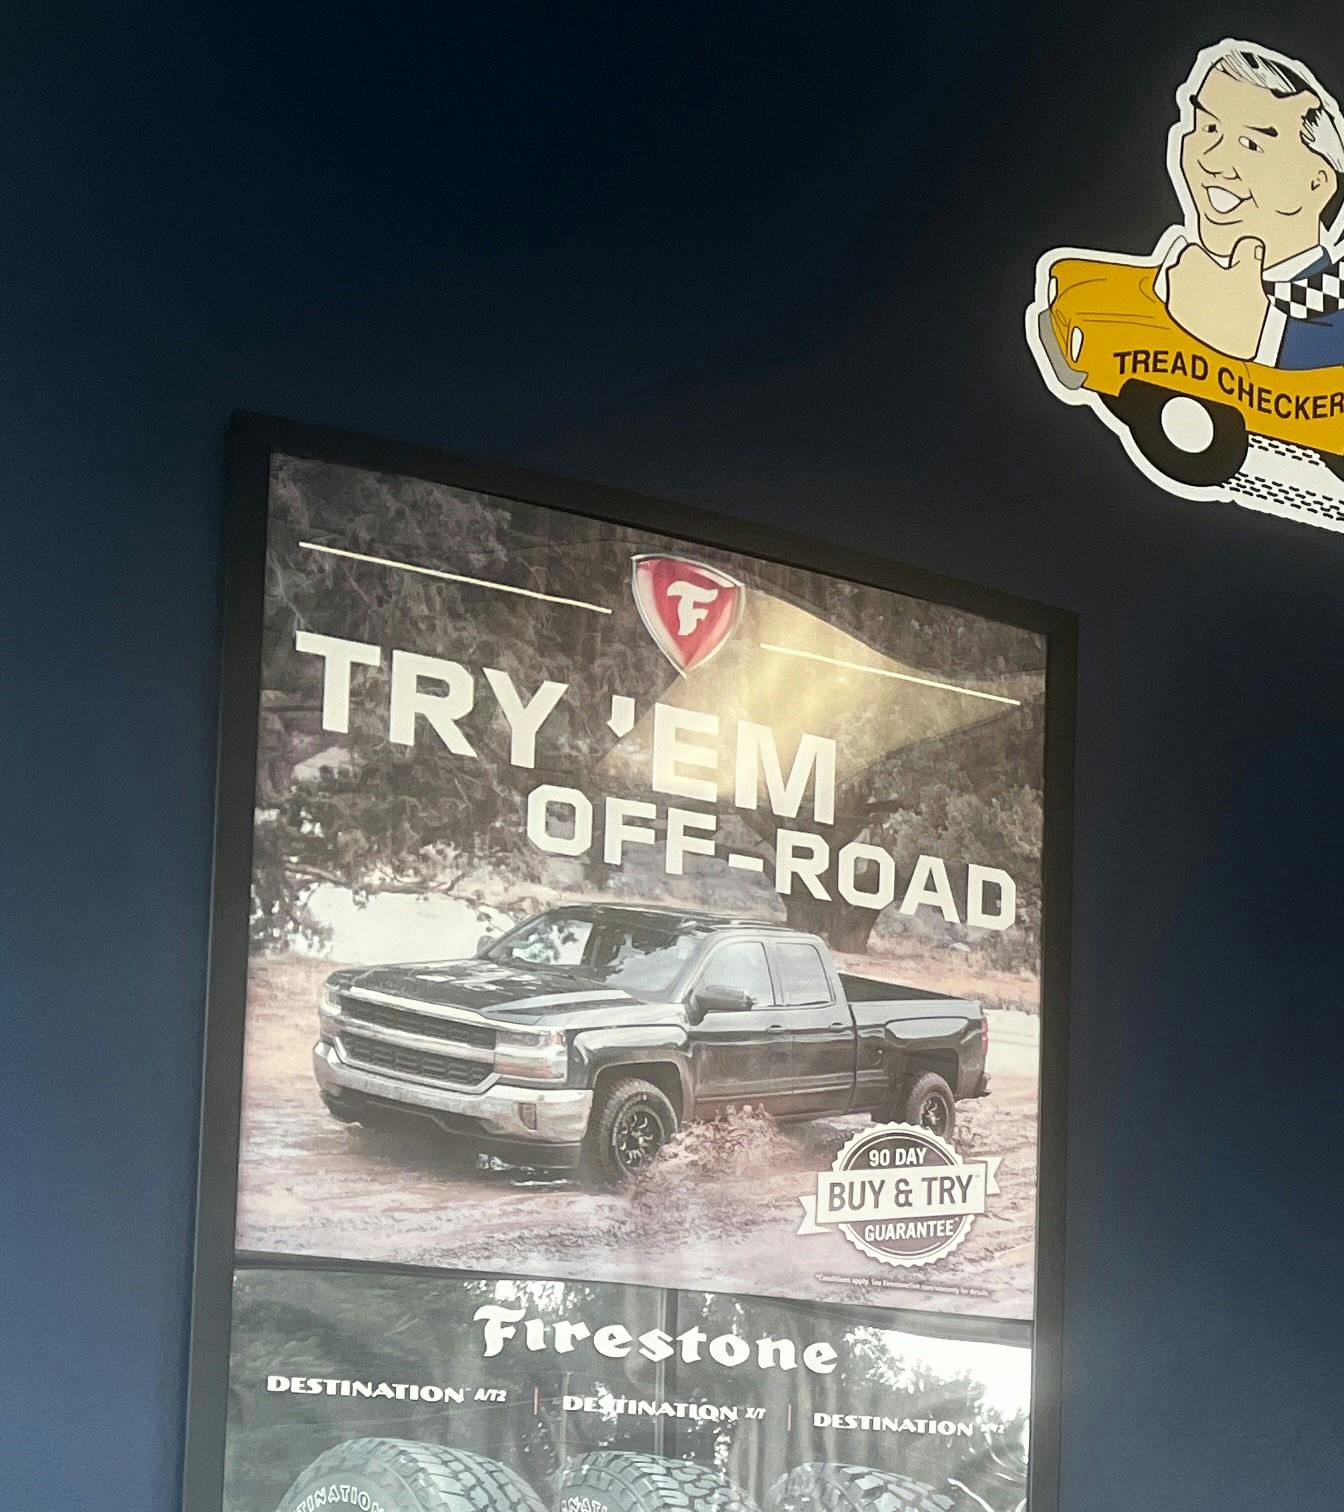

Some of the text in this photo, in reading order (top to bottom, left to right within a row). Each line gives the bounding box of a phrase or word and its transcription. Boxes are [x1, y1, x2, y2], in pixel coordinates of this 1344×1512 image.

[1113, 350, 1209, 382] TREAD
[295, 631, 837, 825] TRY 'EM
[527, 783, 1016, 931] OFF-ROAD
[869, 1147, 927, 1167] 90 DAY
[828, 1174, 974, 1212] BUY & TRY
[864, 1219, 955, 1242] GUARANTEE
[473, 1304, 838, 1374] Firestone
[267, 1375, 507, 1404] DESTINATION A/T2
[562, 1395, 739, 1421] DESTINATION
[813, 1412, 974, 1437] DESTINATION
